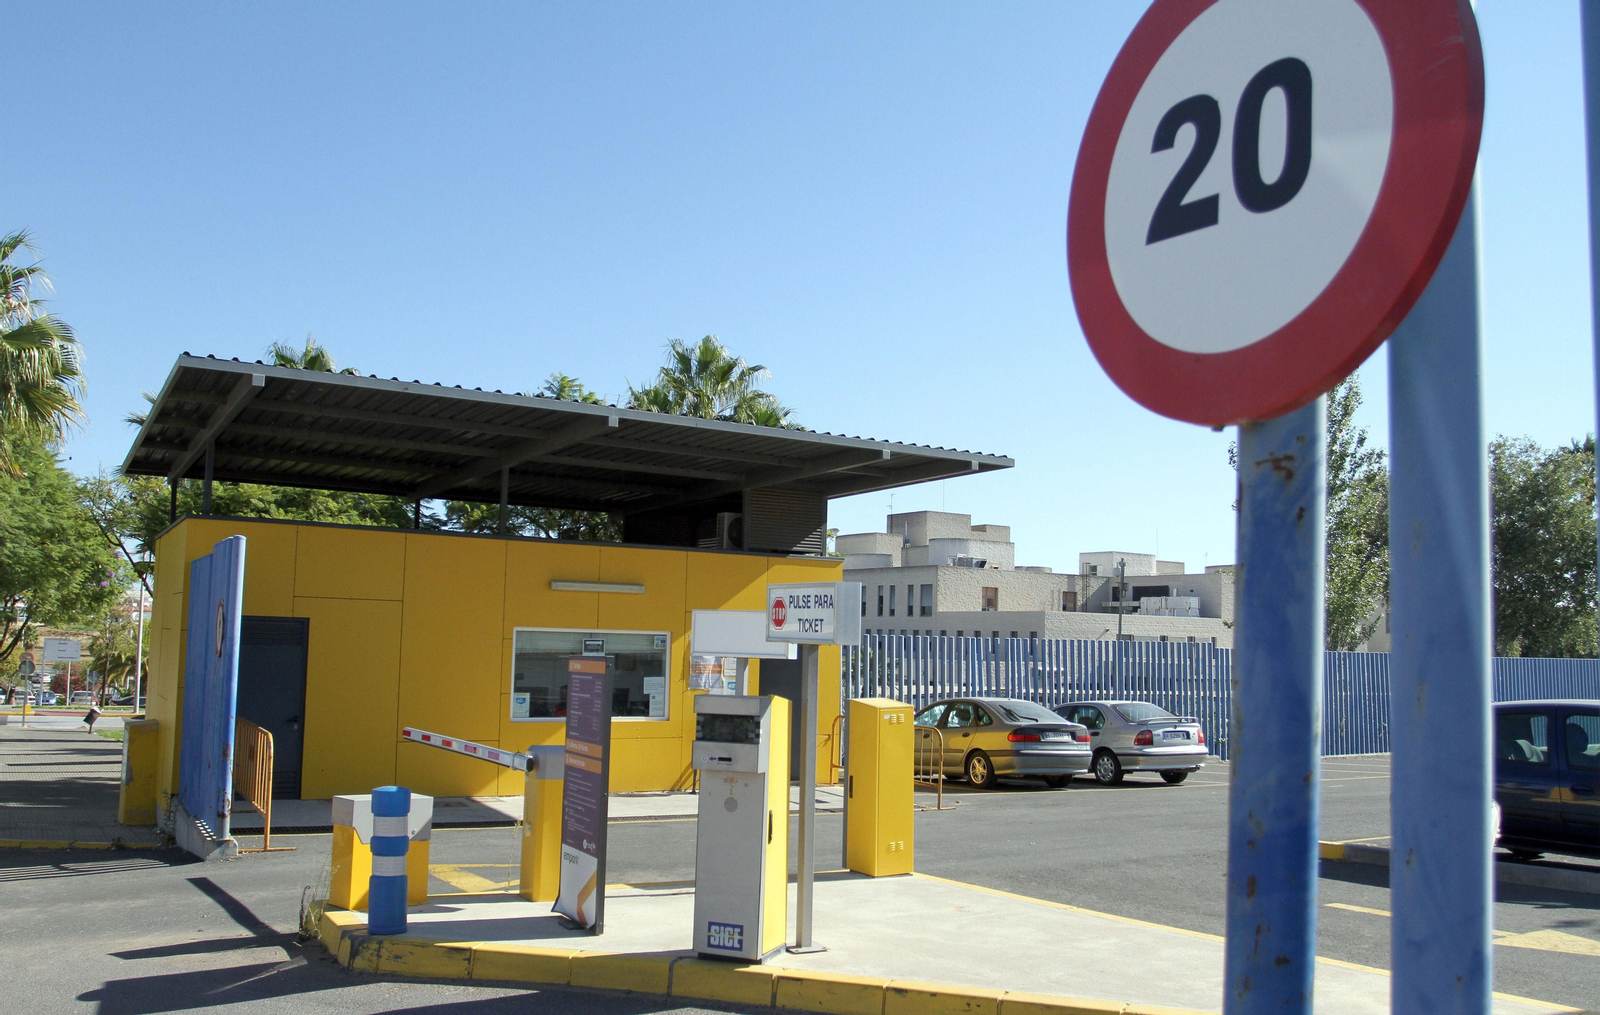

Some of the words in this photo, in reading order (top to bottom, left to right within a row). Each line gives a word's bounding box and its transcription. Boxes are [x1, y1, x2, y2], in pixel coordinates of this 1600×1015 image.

[1145, 57, 1312, 246] 20
[789, 594, 811, 609] PULSE
[813, 594, 834, 609] PARA
[772, 607, 786, 620] STOP
[797, 618, 824, 633] TICKET
[710, 925, 741, 948] SICE
